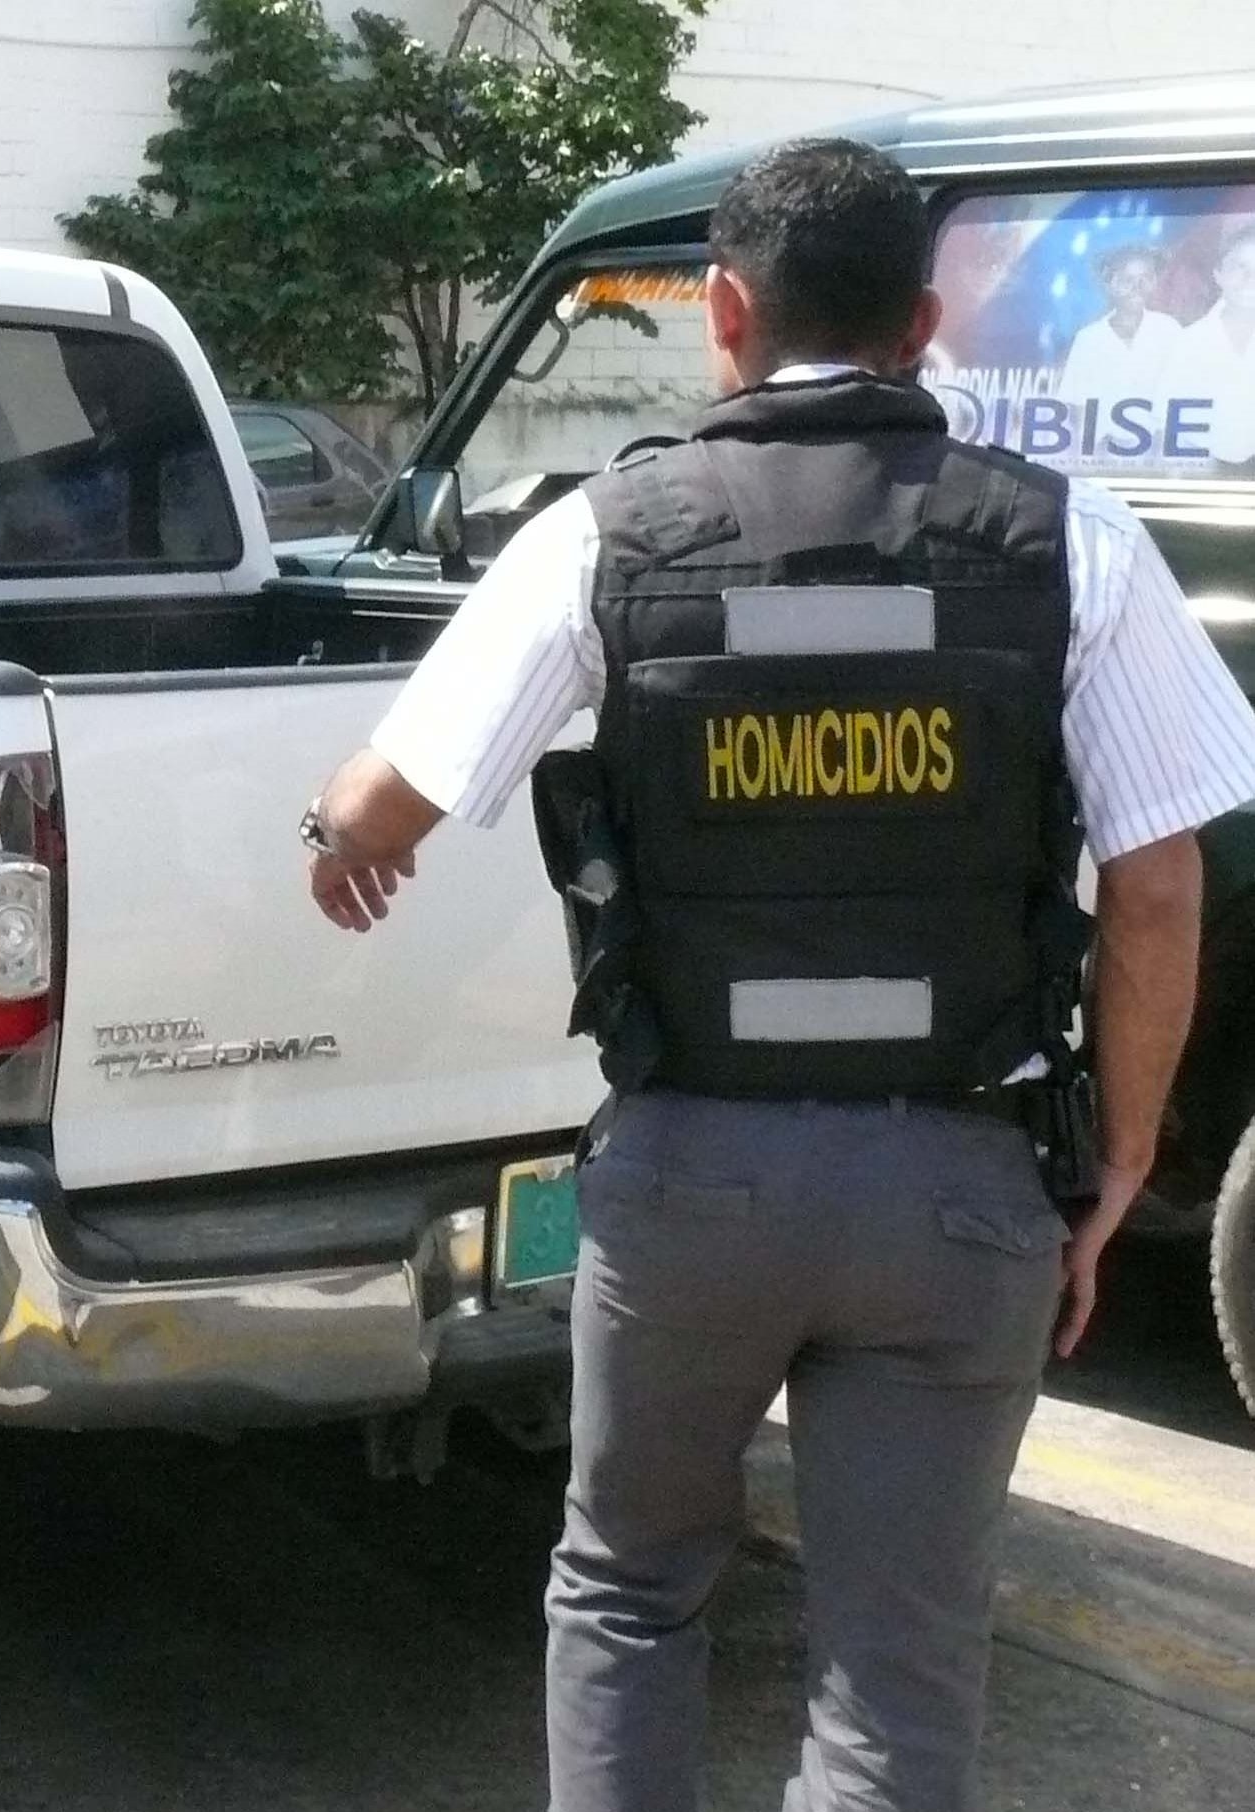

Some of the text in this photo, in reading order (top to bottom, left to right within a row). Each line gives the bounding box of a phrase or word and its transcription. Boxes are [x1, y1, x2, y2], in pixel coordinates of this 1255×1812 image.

[706, 706, 955, 799] HOMICIDIOS
[90, 1031, 341, 1080] TACOMA
[94, 1017, 205, 1048] TOYOTA
